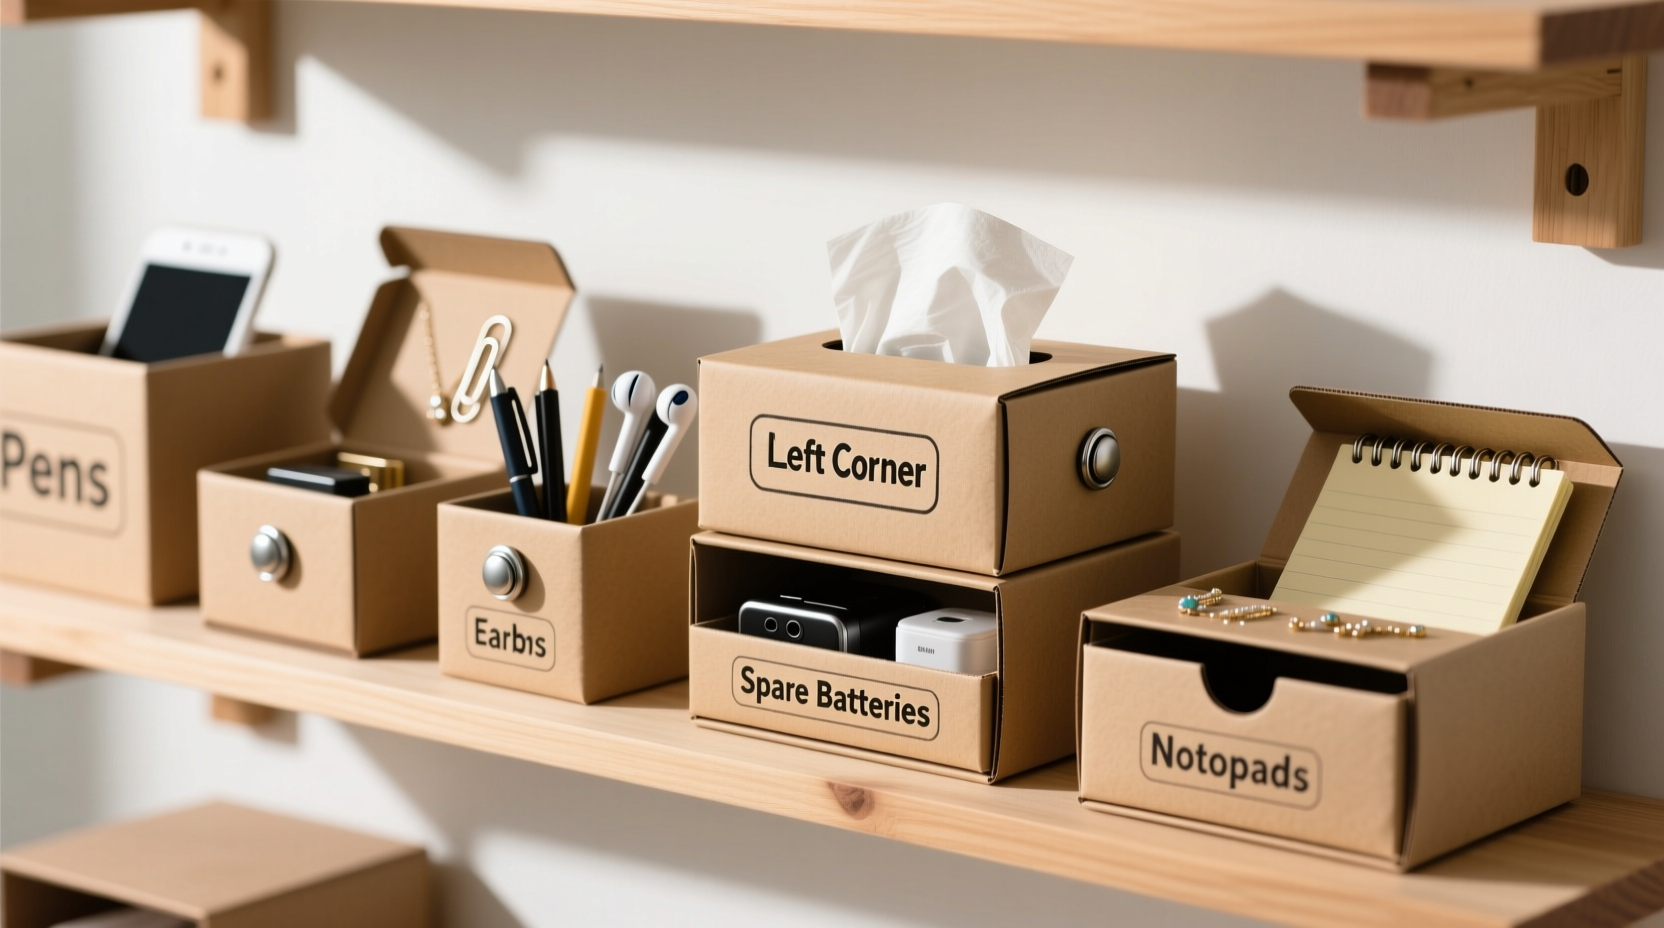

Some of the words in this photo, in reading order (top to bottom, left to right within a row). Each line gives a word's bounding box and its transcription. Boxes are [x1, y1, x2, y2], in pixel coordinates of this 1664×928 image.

[0, 429, 110, 509] Pens
[767, 431, 826, 476] Left
[831, 442, 927, 489] Corner
[740, 665, 809, 705] Spare
[816, 679, 931, 728] Batteries
[1151, 731, 1310, 794] Notopads
